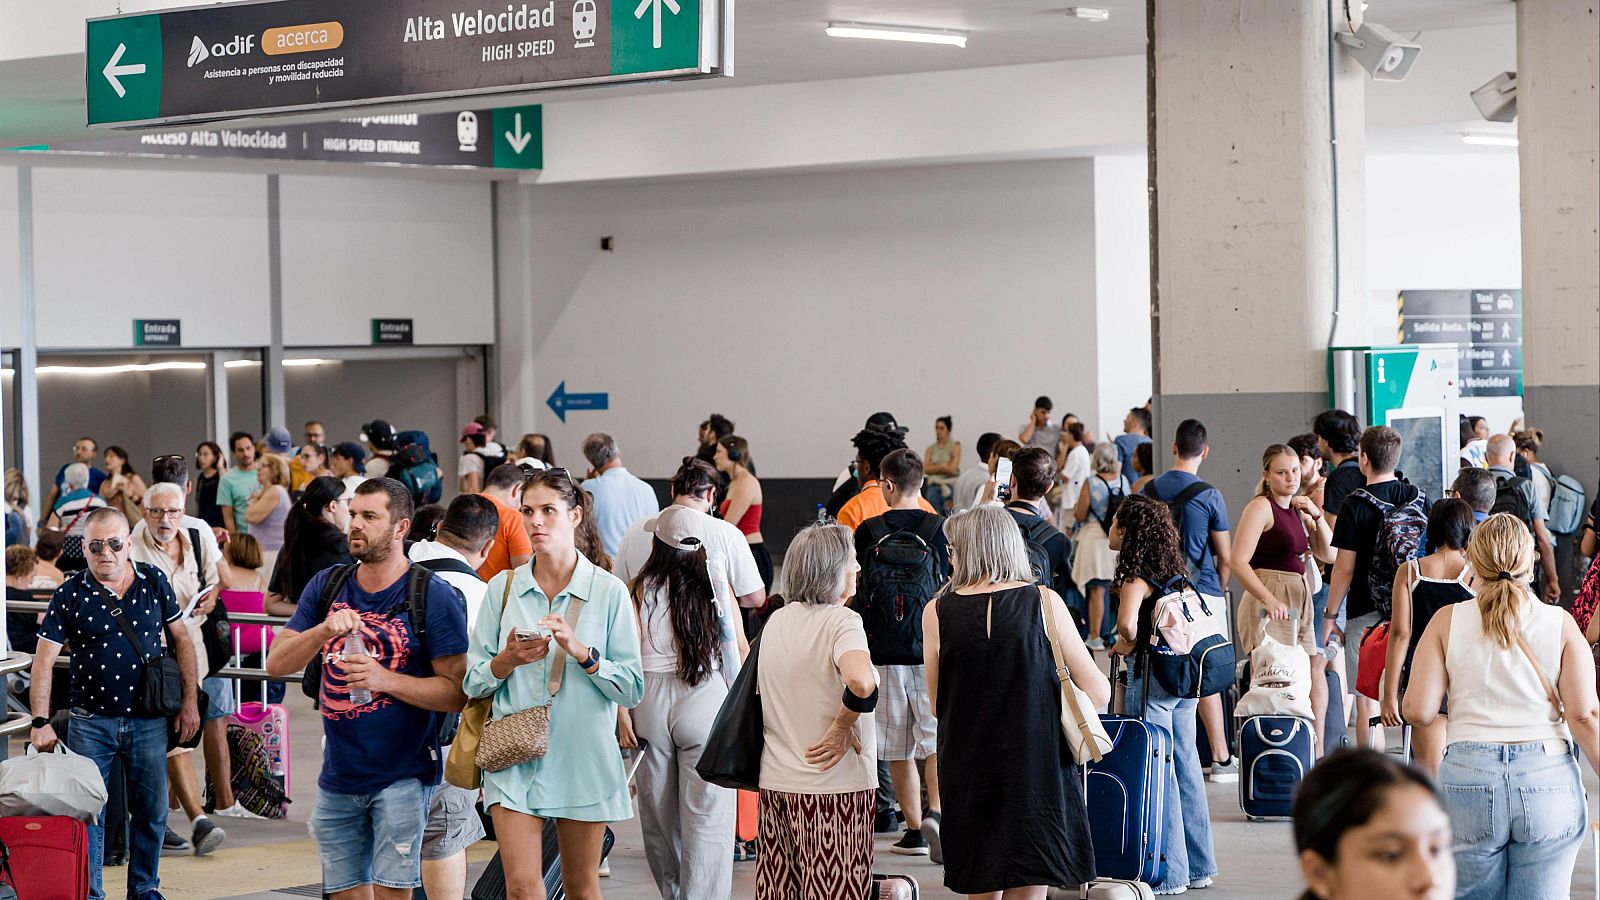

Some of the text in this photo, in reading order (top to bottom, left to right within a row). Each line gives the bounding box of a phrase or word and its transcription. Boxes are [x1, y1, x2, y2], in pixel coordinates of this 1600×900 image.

[404, 1, 555, 42] Alta Velocidad
[211, 34, 255, 57] adif
[277, 29, 328, 48] acerca
[482, 39, 555, 62] HIGH SPEED
[204, 57, 344, 79] Asistencia a personas con discapacidad
[268, 68, 344, 85] y movilidad reducida
[190, 130, 218, 147] Alta
[221, 129, 287, 149] Velocidad
[323, 137, 421, 154] HIGH SPEED ENTRANCE
[144, 323, 177, 334] Entrada
[380, 322, 409, 333] Entrada
[1465, 376, 1510, 388] Velocidad
